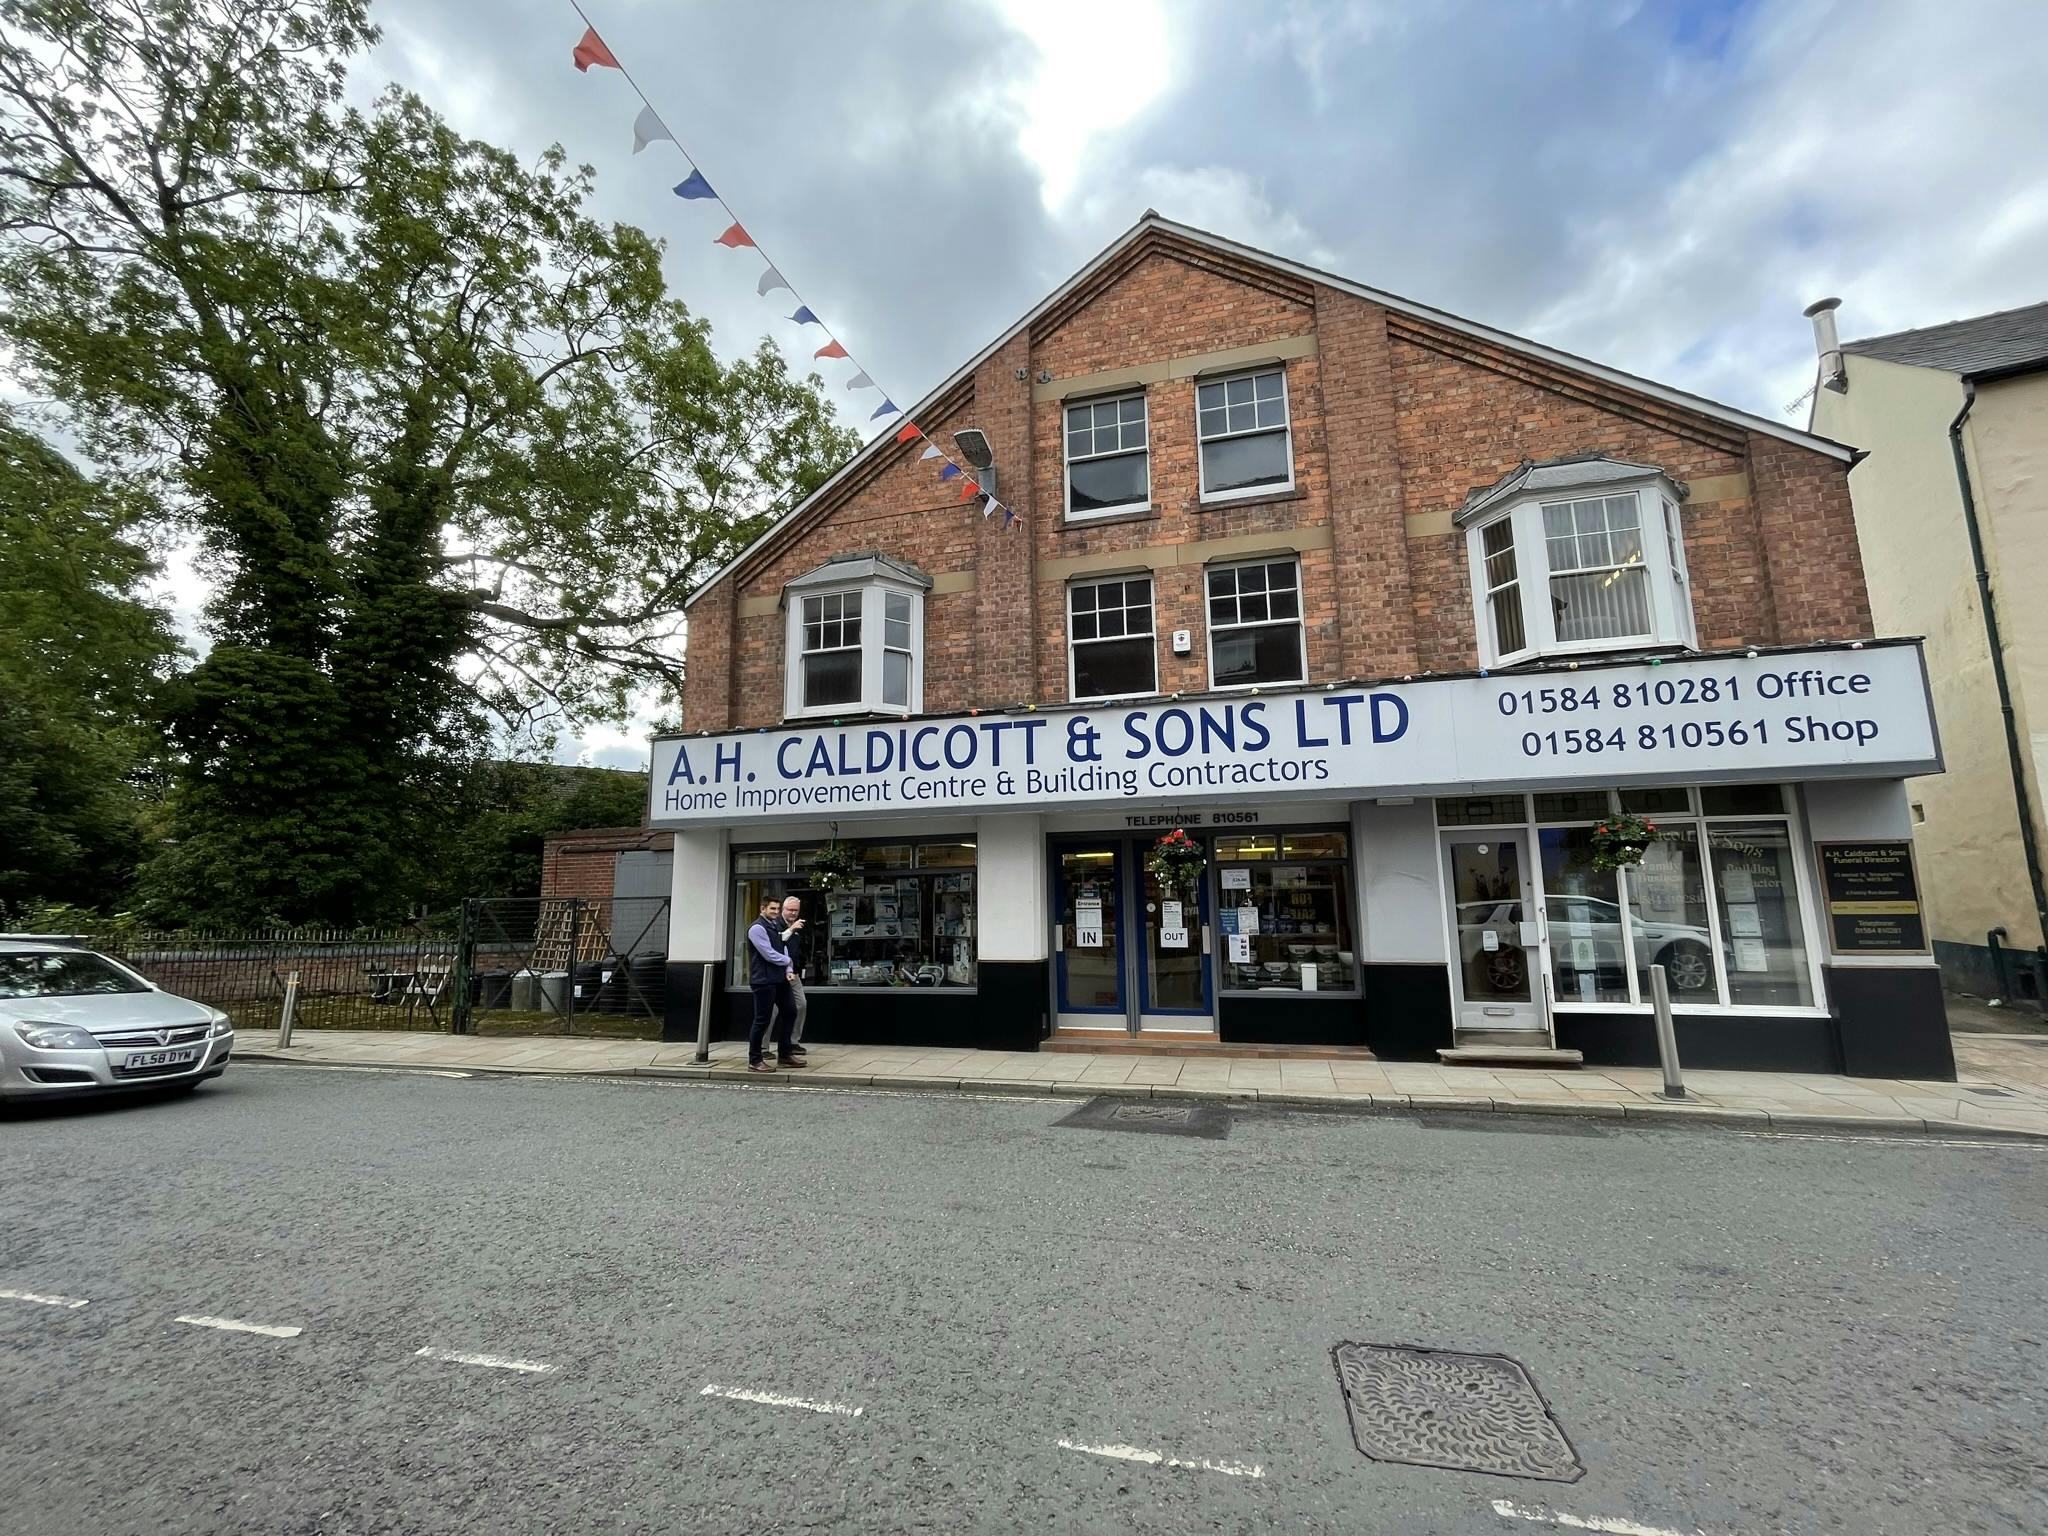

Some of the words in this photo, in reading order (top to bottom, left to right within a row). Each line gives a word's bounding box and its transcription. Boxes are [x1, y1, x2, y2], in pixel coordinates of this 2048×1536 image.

[1499, 684, 1601, 716] 01584
[1612, 676, 1740, 709] 810281
[1756, 671, 1872, 700] Office
[666, 742, 757, 787] A.H.
[776, 719, 1048, 780] CALDICOTT
[1066, 716, 1103, 763] &
[1124, 702, 1271, 760] SONS
[1296, 692, 1409, 748] LTD
[1522, 727, 1627, 757] 01584
[1638, 719, 1768, 750] 810561
[1784, 716, 1879, 747] Shop
[664, 788, 727, 812] Home
[735, 778, 892, 812] Improvement
[900, 775, 987, 801] Centre
[996, 771, 1016, 796] &
[1026, 763, 1139, 796] Building
[1148, 758, 1329, 788] Contractors
[1125, 813, 1202, 827] TELEPHONE
[1212, 811, 1259, 824] 810561
[1722, 835, 1764, 858] Sons
[1844, 850, 1879, 858] Caldicott
[1888, 849, 1906, 857] Sons
[1864, 856, 1900, 864] Directors
[1082, 931, 1097, 944] IN
[1164, 932, 1184, 941] OUT
[131, 1053, 166, 1066] FL58
